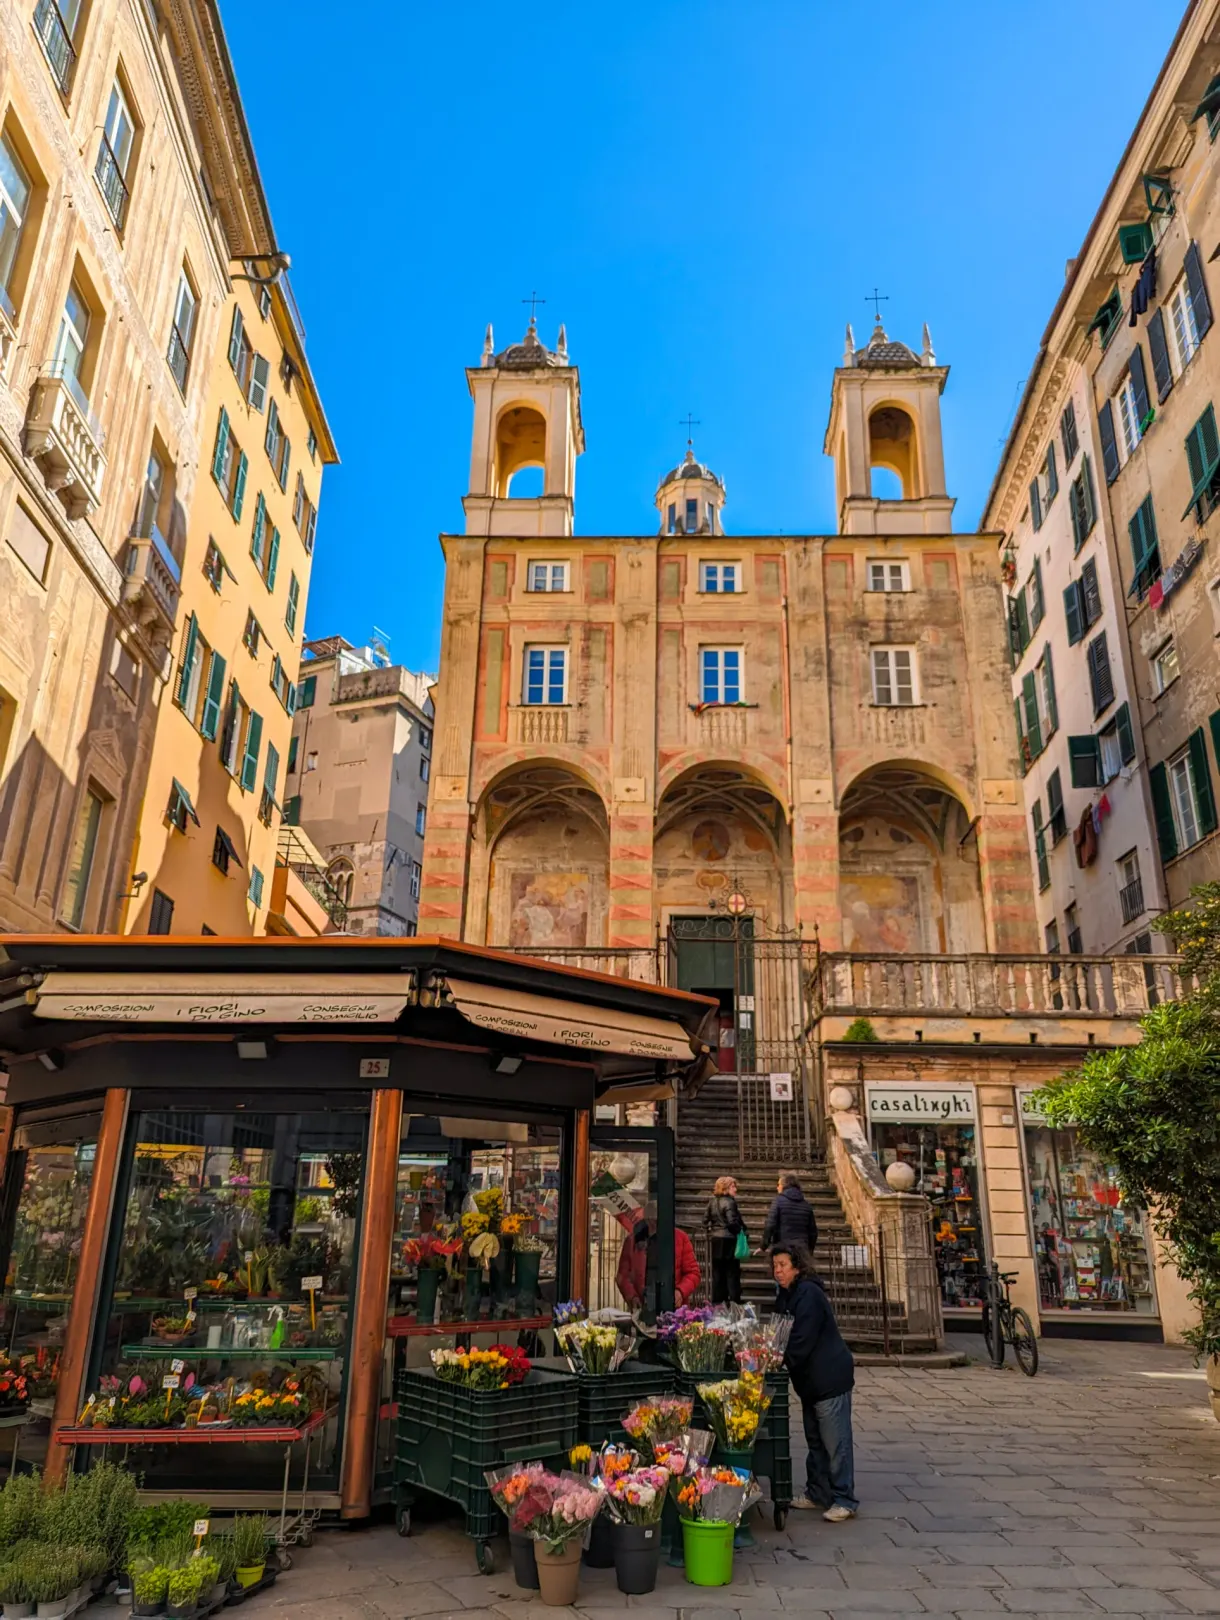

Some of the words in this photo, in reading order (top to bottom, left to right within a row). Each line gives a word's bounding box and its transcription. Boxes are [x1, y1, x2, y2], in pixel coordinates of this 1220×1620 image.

[63, 1004, 155, 1012] COMPOSIZIONI
[188, 1003, 239, 1015] FIORI
[303, 1004, 377, 1013] CONSEGNE
[191, 1013, 212, 1022] DI
[219, 1008, 266, 1020] GINO
[311, 1012, 379, 1020] DOMICILIO
[475, 1014, 538, 1030] COMPOSIZIONI
[560, 1030, 594, 1039] FIORI
[582, 1039, 611, 1047] GINO
[630, 1040, 673, 1052] CONSEGNE
[367, 1061, 380, 1074] 25
[870, 1094, 972, 1119] casalinghi
[609, 1192, 620, 1203] 25
